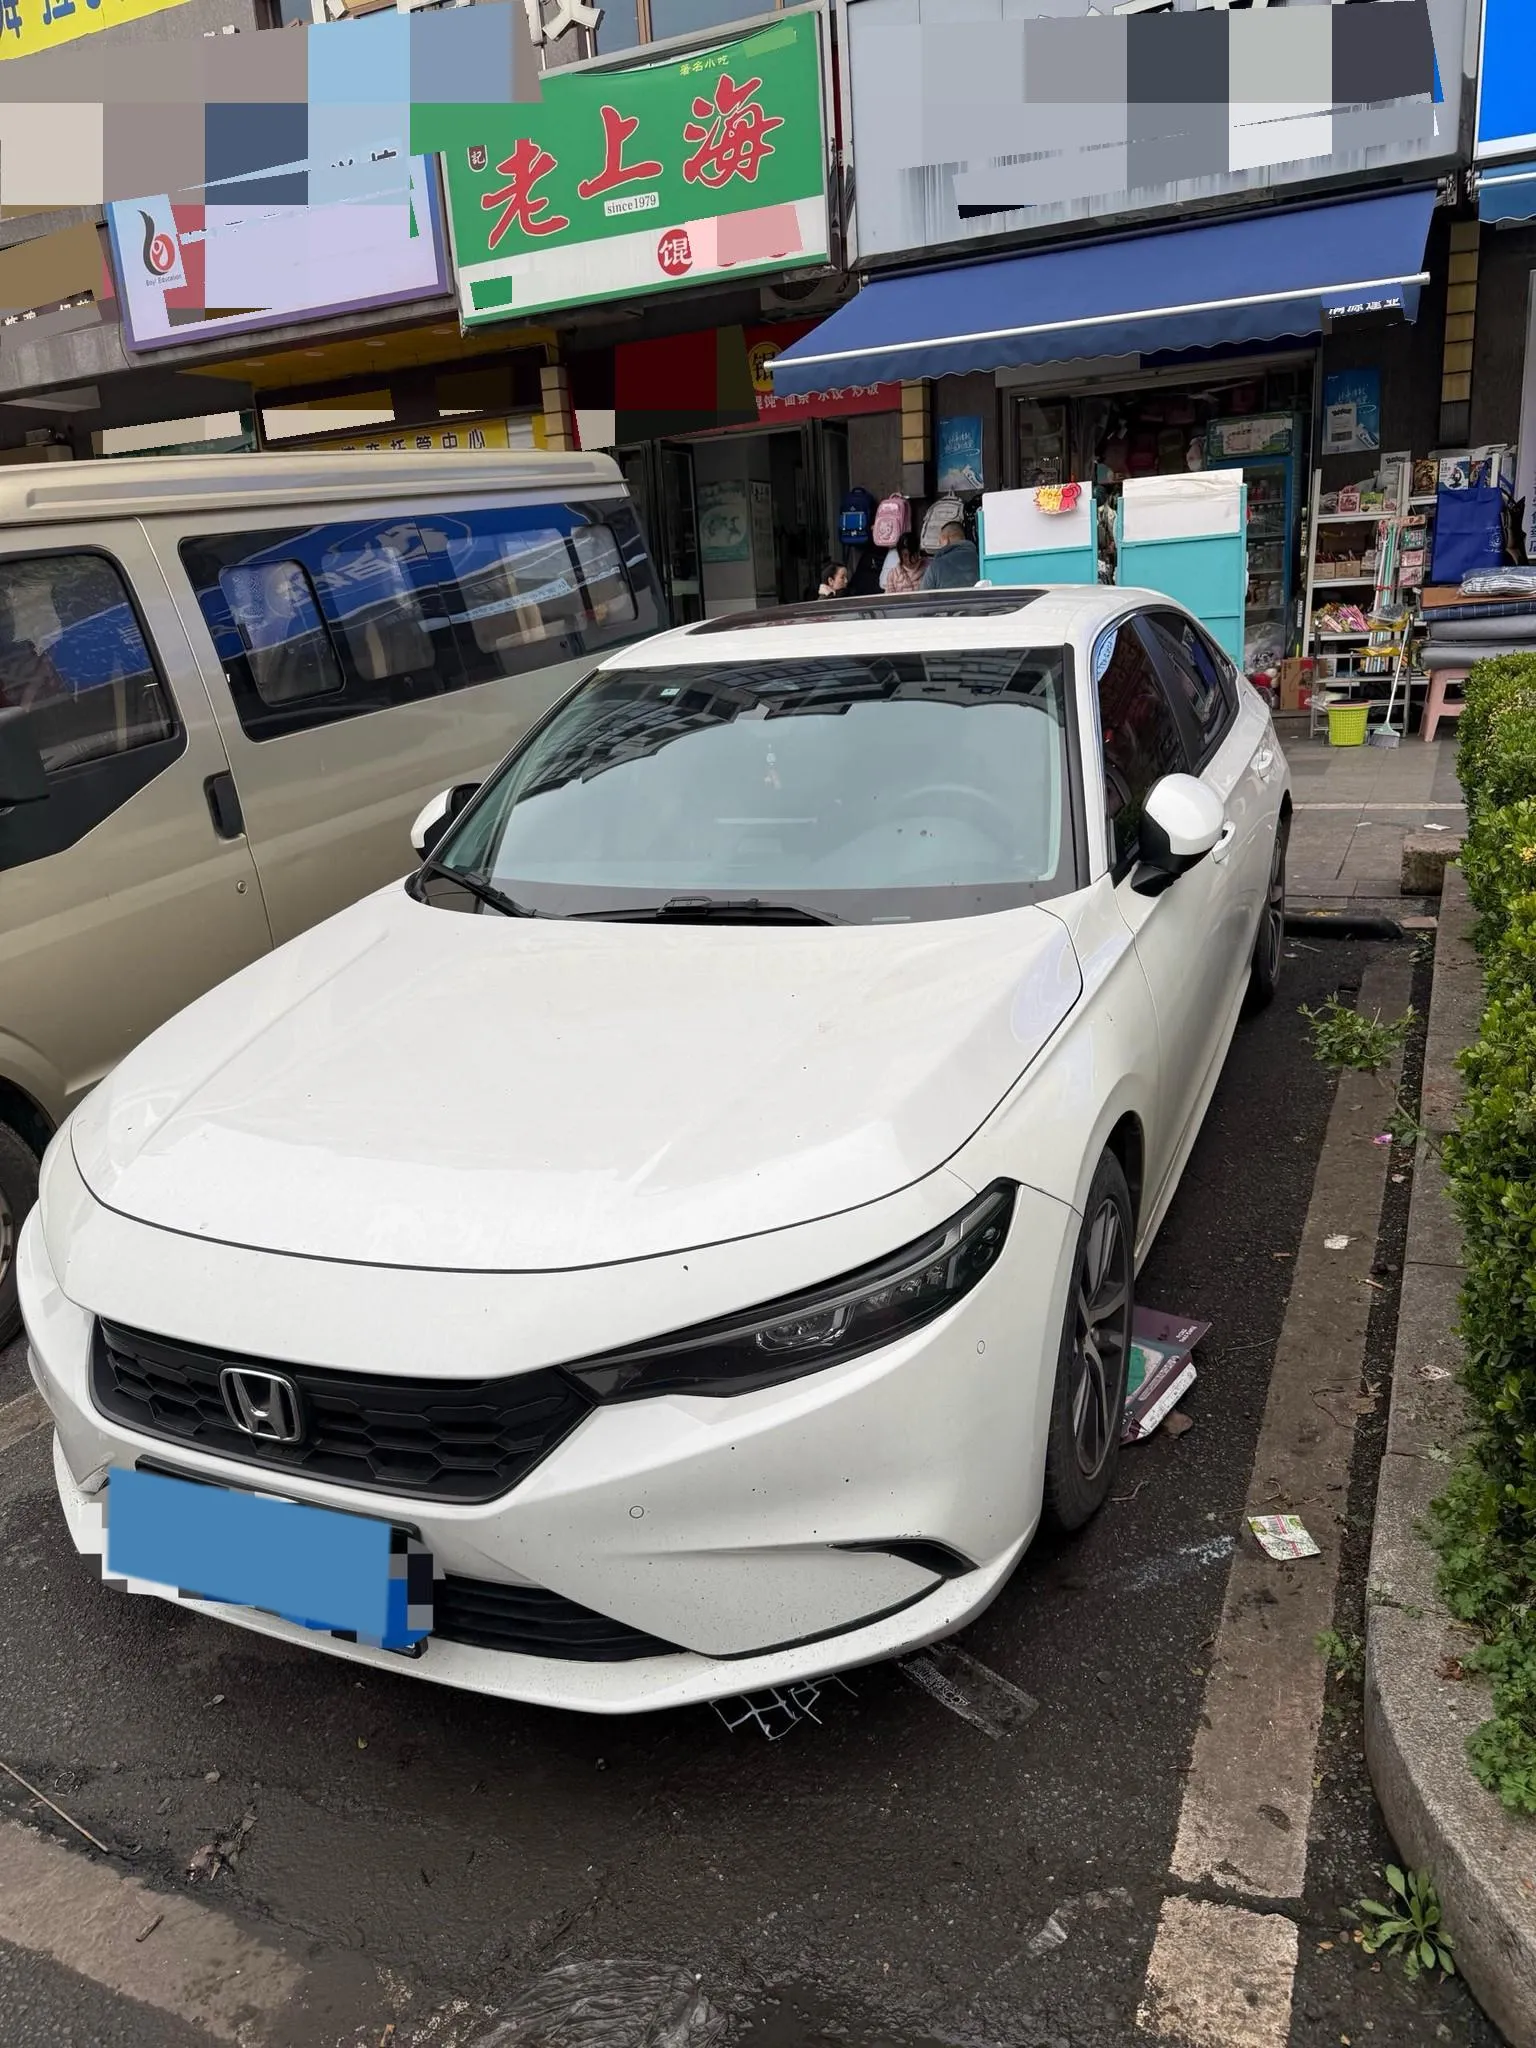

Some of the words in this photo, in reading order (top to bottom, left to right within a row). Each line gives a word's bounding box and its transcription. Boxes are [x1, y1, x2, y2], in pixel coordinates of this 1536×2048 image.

[680, 55, 729, 76] 著名小吃
[481, 74, 785, 250] 老上海
